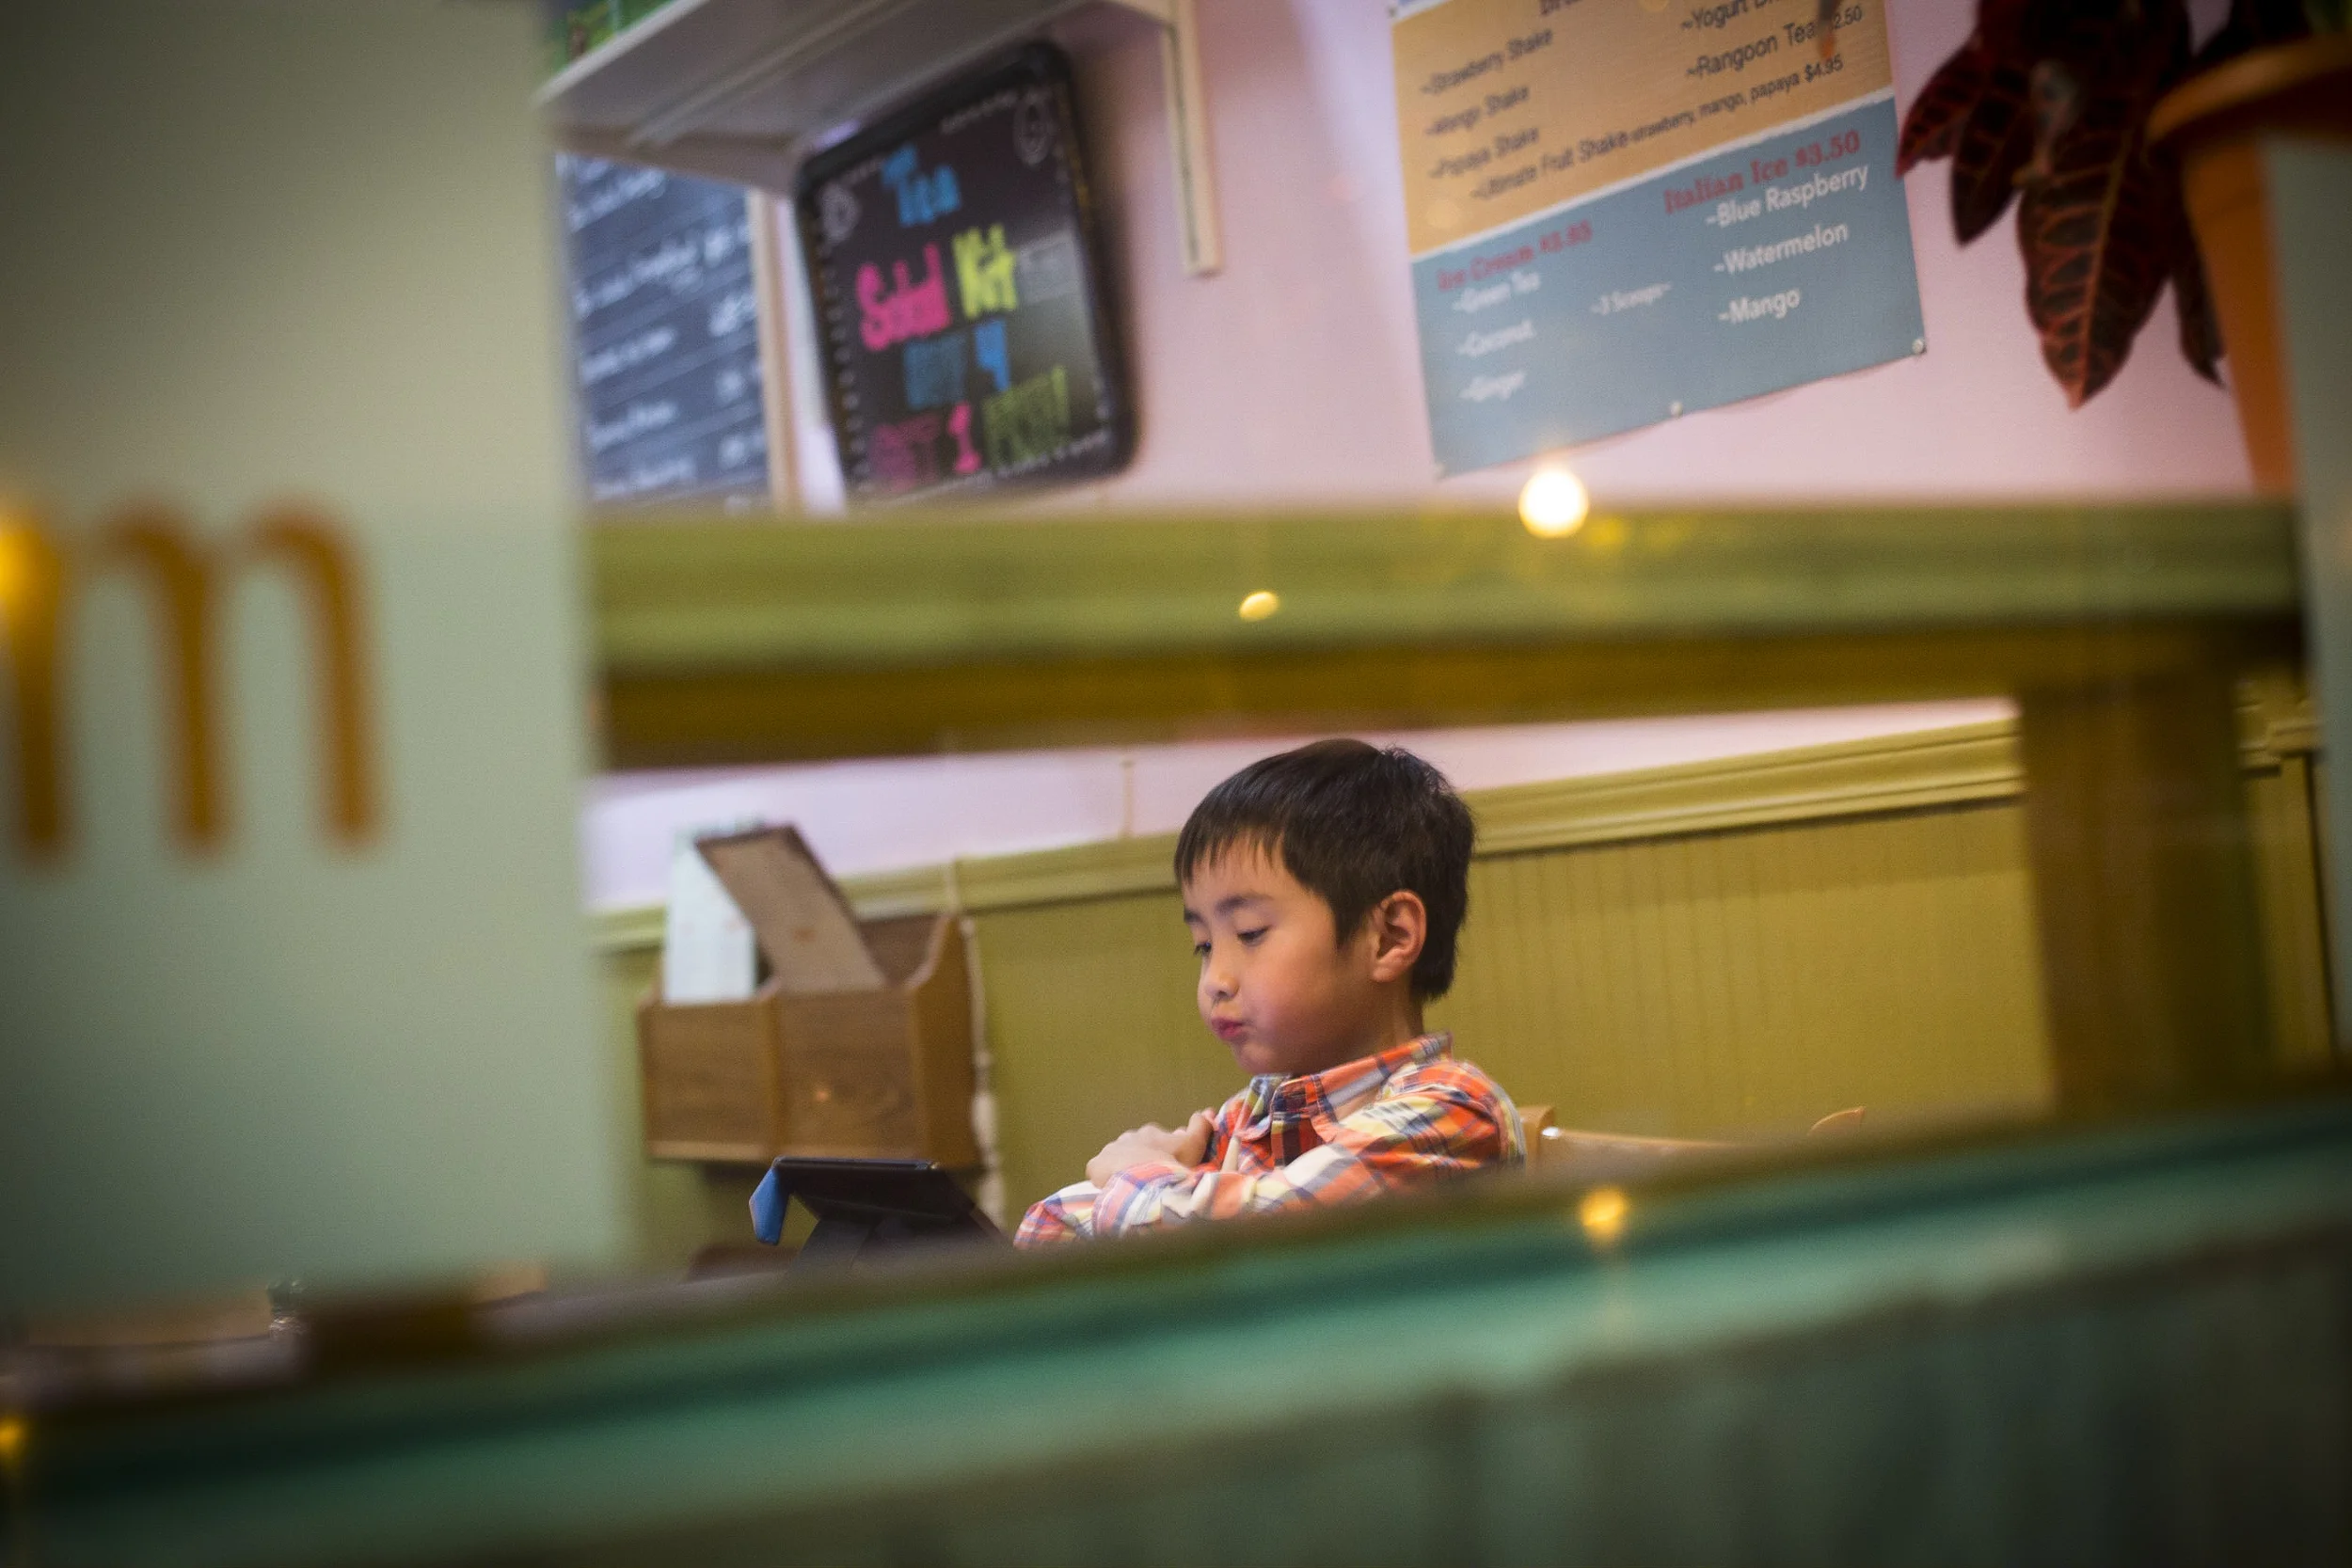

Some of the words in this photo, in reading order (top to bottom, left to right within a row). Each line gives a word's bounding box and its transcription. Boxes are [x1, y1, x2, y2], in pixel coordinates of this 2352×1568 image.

[1507, 28, 1553, 60] Shake
[1784, 21, 1816, 45] Tea
[1486, 86, 1530, 117] Shake
[1540, 147, 1574, 172] Fruit
[1750, 71, 1800, 101] papaya
[1804, 53, 1844, 83] $4.95
[1494, 127, 1539, 158] Shake
[1664, 172, 1744, 214] Italian
[1751, 157, 1788, 184] Ice
[1795, 129, 1860, 167] $3.50
[1765, 164, 1868, 213] Raspberry
[1438, 268, 1467, 292] Ice
[1470, 245, 1535, 281] Cream
[1511, 270, 1540, 294] Tea
[947, 401, 981, 473] 1
